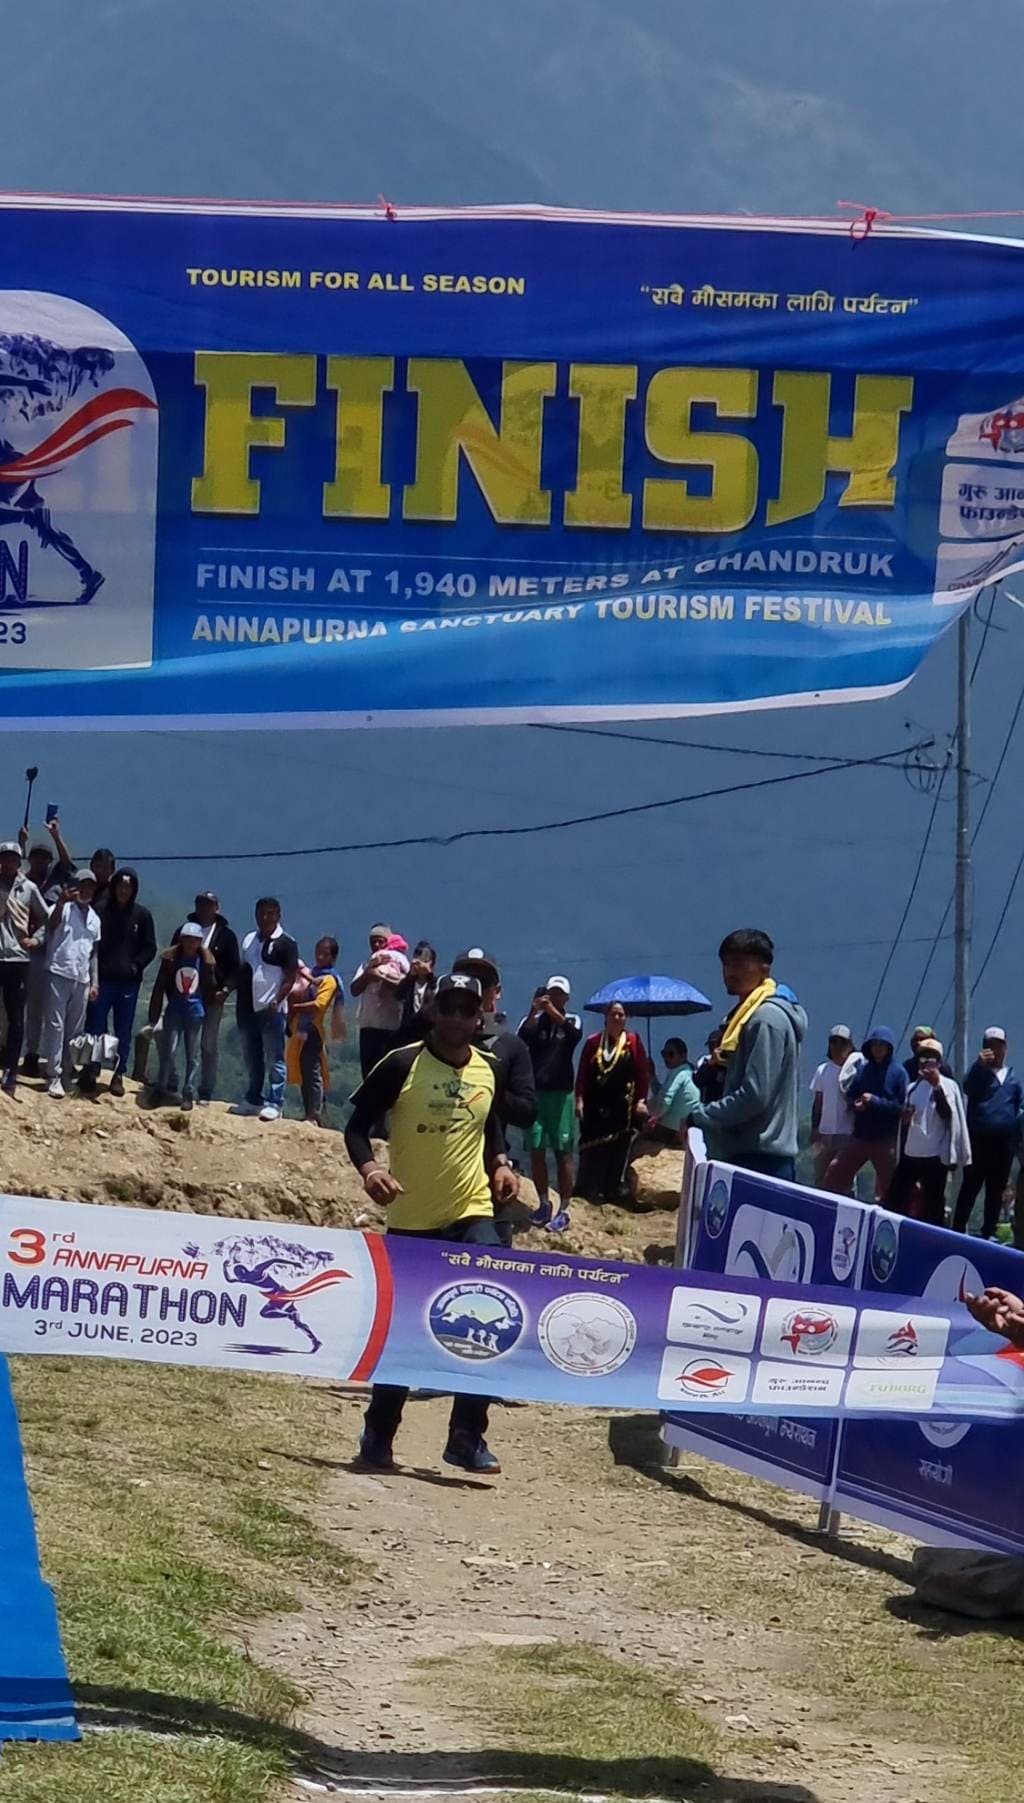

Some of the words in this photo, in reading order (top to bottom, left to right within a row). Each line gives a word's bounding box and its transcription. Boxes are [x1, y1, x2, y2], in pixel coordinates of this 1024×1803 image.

[186, 268, 302, 289] TOURISM
[309, 272, 360, 290] FOR
[367, 273, 415, 292] ALL
[422, 274, 526, 296] SEASON
[691, 284, 779, 311] मौसमका
[786, 289, 835, 313] लागि
[190, 351, 914, 532] FINISH
[197, 564, 315, 591] FINISH
[327, 569, 372, 592] AT
[385, 570, 476, 600] 1,940
[489, 575, 629, 598] METERS
[641, 565, 684, 585] AT
[694, 550, 894, 577] GHANDRUK
[192, 615, 388, 644] ANNAPURNA
[400, 604, 584, 633] SANCTUARY
[595, 595, 734, 621] TOURISM
[744, 596, 892, 625] FESTIVAL
[53, 1248, 209, 1281] ANNAPURNA
[2, 1272, 247, 1328] MARATHON
[34, 1319, 63, 1336] 3rd
[68, 1323, 136, 1345] JUNE,
[140, 1329, 198, 1347] 2023
